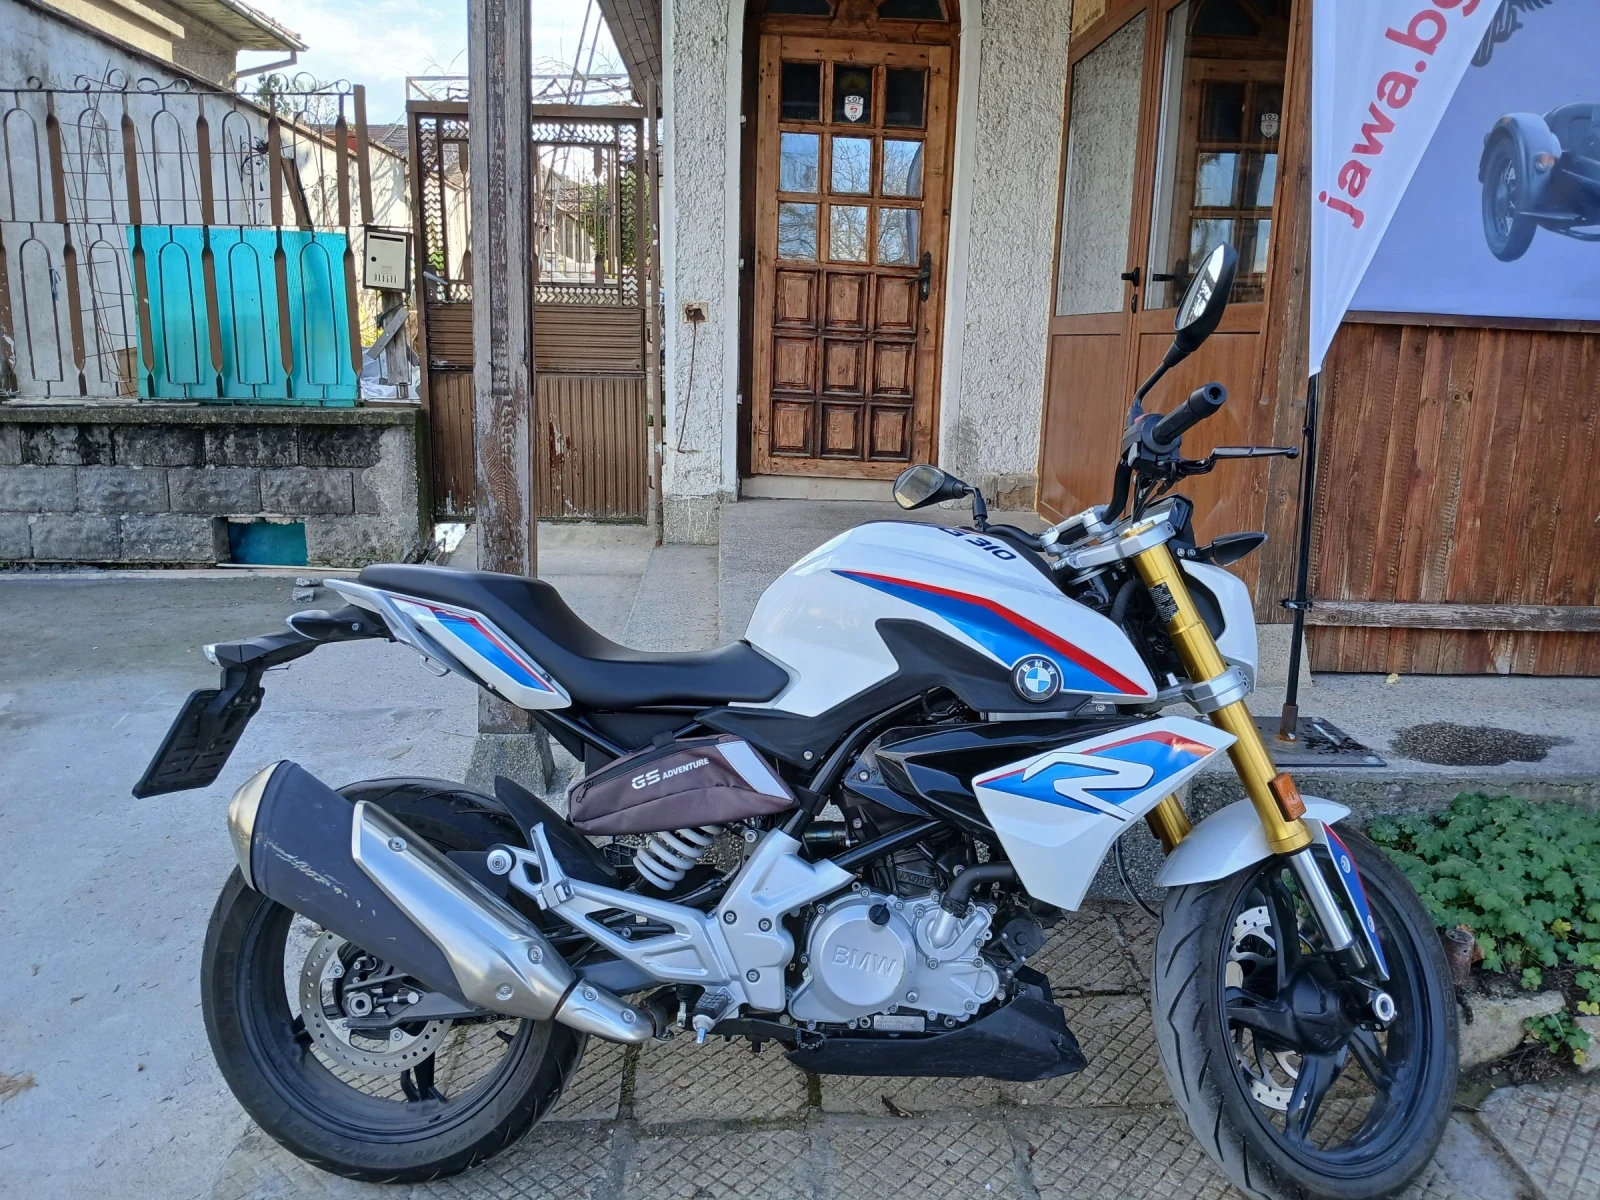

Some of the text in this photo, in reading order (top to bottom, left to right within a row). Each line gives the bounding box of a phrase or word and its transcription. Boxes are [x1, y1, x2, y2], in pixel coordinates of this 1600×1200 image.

[964, 537, 1017, 560] 310
[1021, 660, 1056, 675] BMW
[631, 757, 710, 790] GS ADVENTURE
[831, 944, 898, 978] BMW
[1437, 963, 1455, 1030] ROSSO
